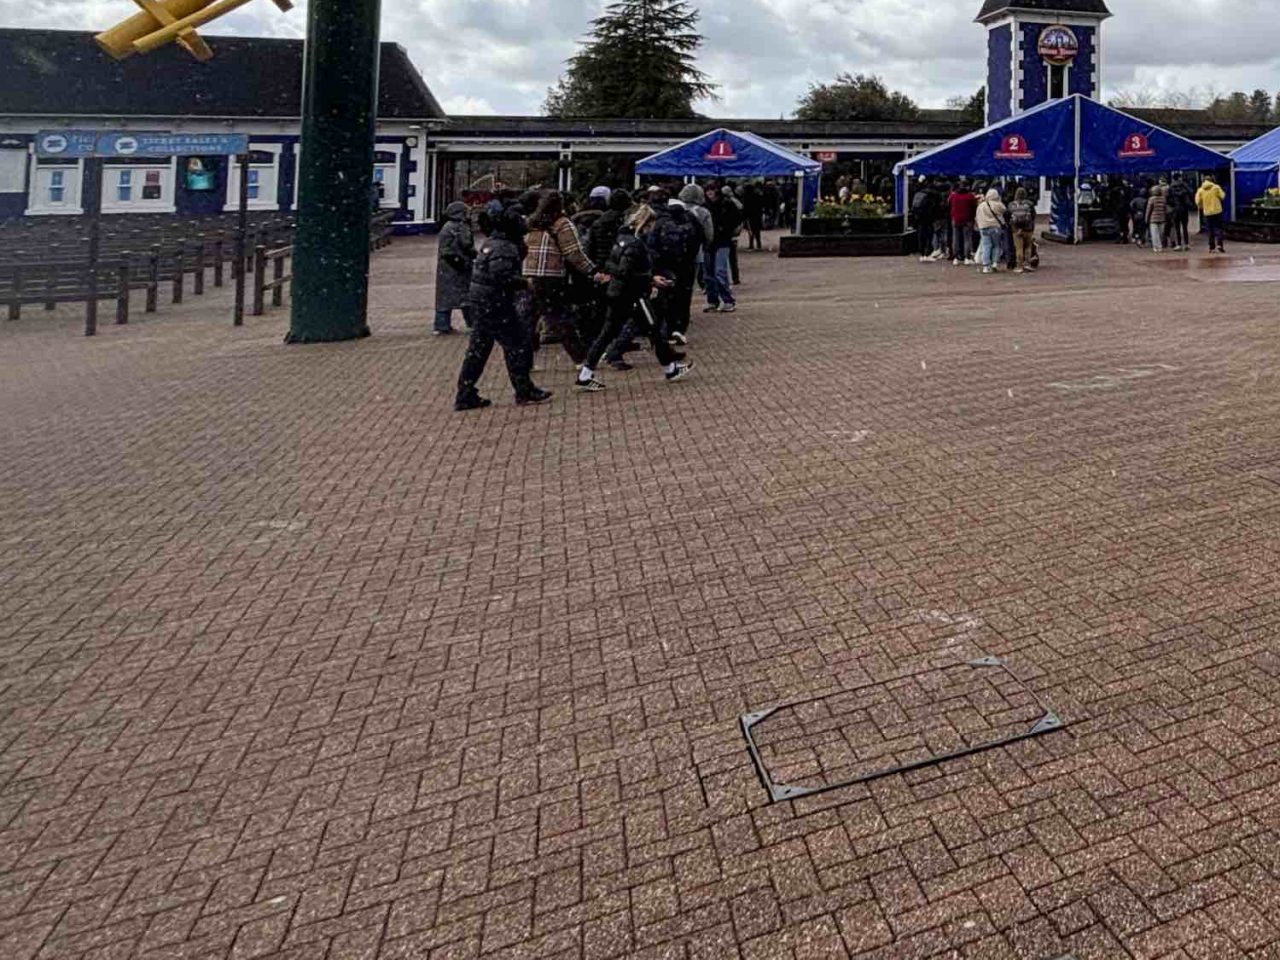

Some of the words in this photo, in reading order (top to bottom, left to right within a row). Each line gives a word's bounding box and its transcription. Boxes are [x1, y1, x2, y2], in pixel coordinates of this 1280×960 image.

[719, 142, 724, 155] 1
[1009, 138, 1019, 150] 2
[1132, 136, 1141, 149] 3
